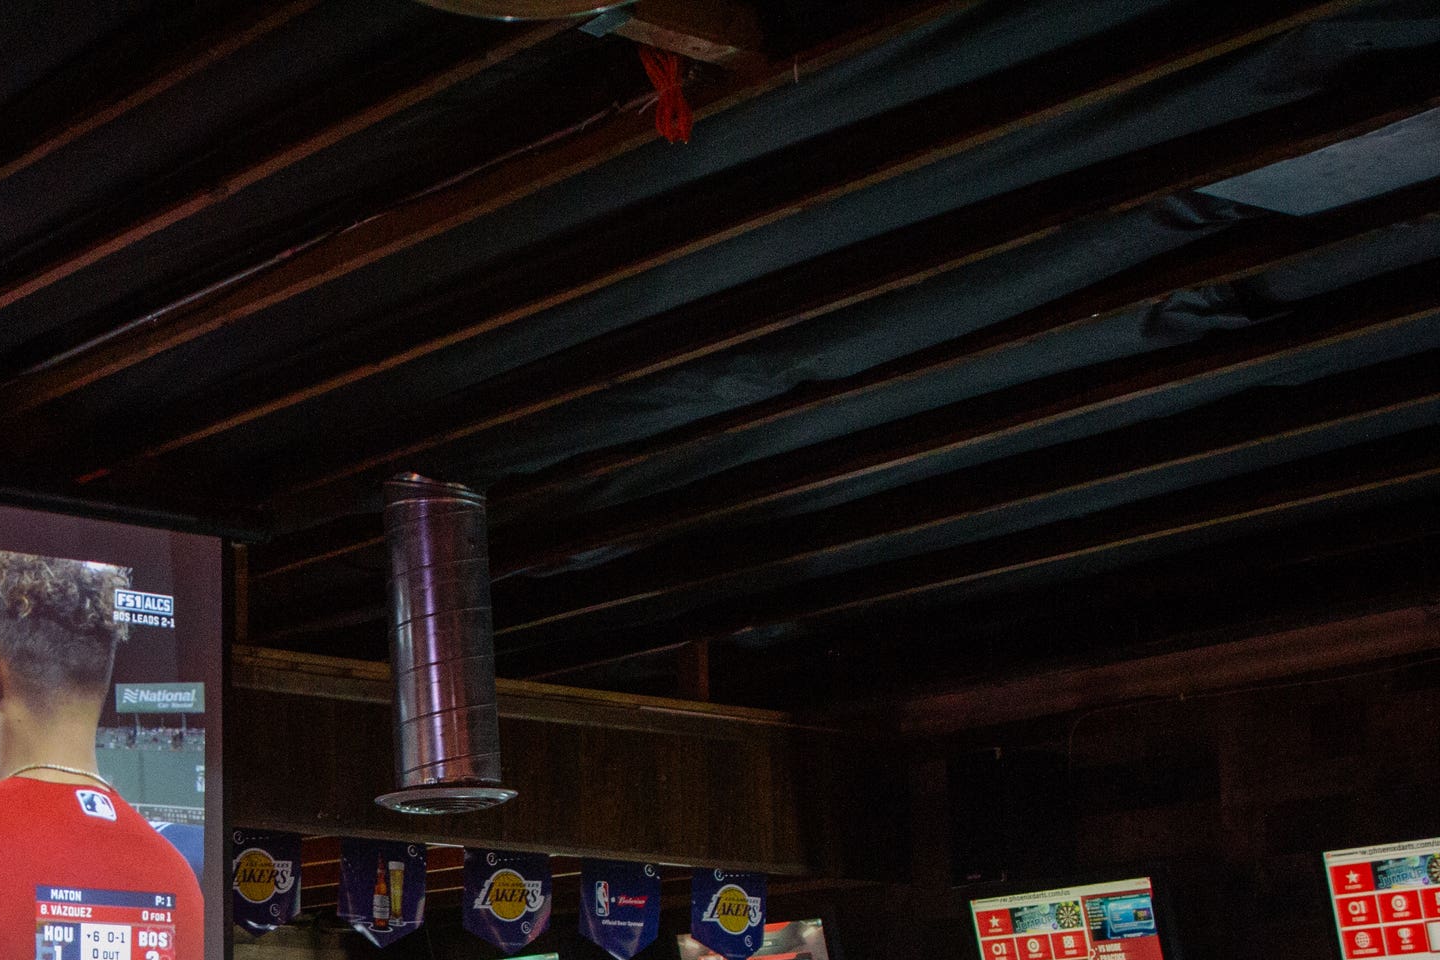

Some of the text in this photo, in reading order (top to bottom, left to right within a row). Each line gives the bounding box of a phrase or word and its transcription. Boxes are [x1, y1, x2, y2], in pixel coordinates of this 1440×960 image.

[117, 594, 171, 612] FS1 ALCS
[113, 611, 175, 628] BOS LEADS 2-1
[139, 688, 195, 702] National
[50, 889, 82, 902] MATON
[481, 882, 539, 909] LAKERS
[710, 896, 759, 924] LAKERS
[1348, 900, 1367, 915] 01
[150, 912, 165, 922] FOR
[166, 912, 172, 922] 1
[44, 925, 74, 943] HOU
[93, 931, 126, 944] 6 0-1
[138, 931, 168, 948] BOS
[92, 948, 120, 960] 0 OUT
[992, 942, 1008, 956] 01
